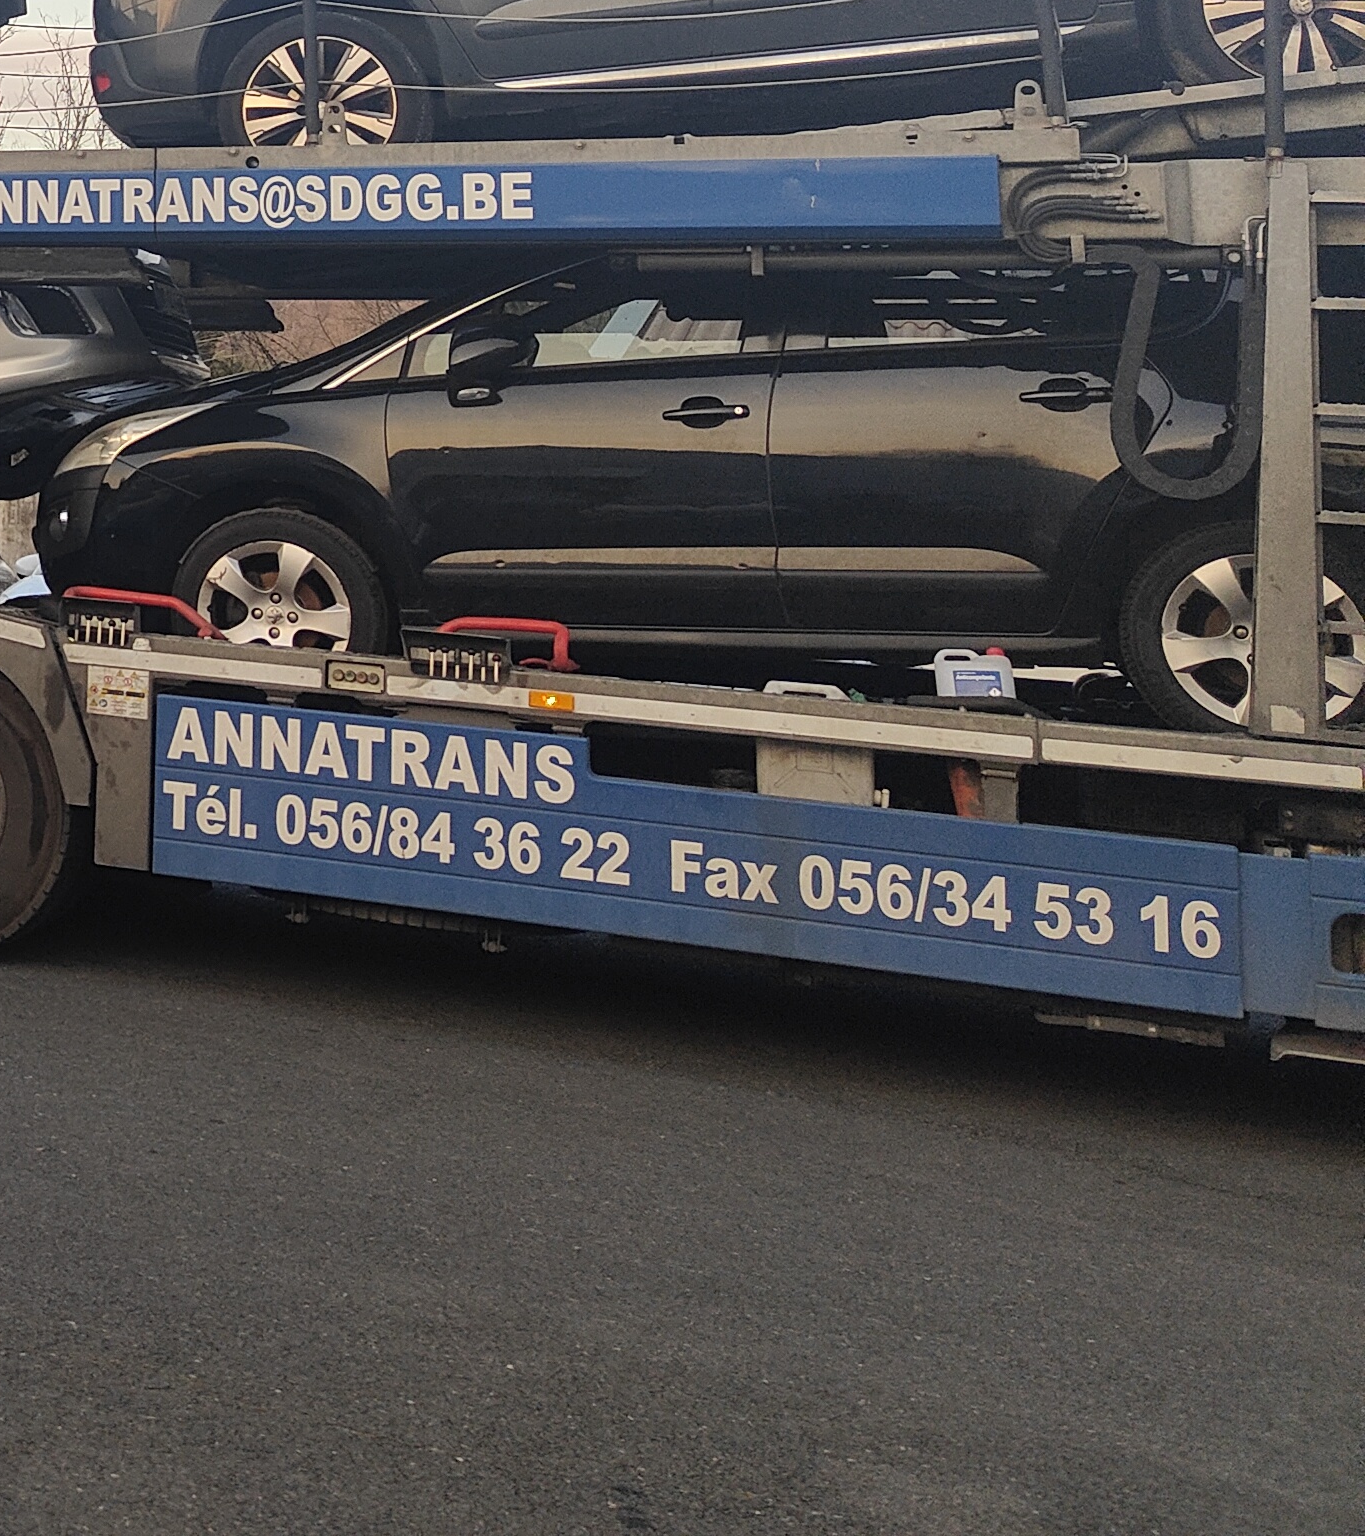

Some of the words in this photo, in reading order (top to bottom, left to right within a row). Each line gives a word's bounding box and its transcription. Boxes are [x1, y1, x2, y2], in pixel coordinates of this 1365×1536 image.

[167, 707, 575, 805] ANNATRANS
[162, 780, 258, 840] Tél.
[275, 794, 456, 864] 056/84
[473, 817, 541, 875] 36
[559, 827, 631, 887] 22
[669, 839, 779, 905] Fax
[799, 854, 1012, 932] 056/34
[1033, 882, 1114, 945] 53
[1140, 895, 1222, 959] 16
